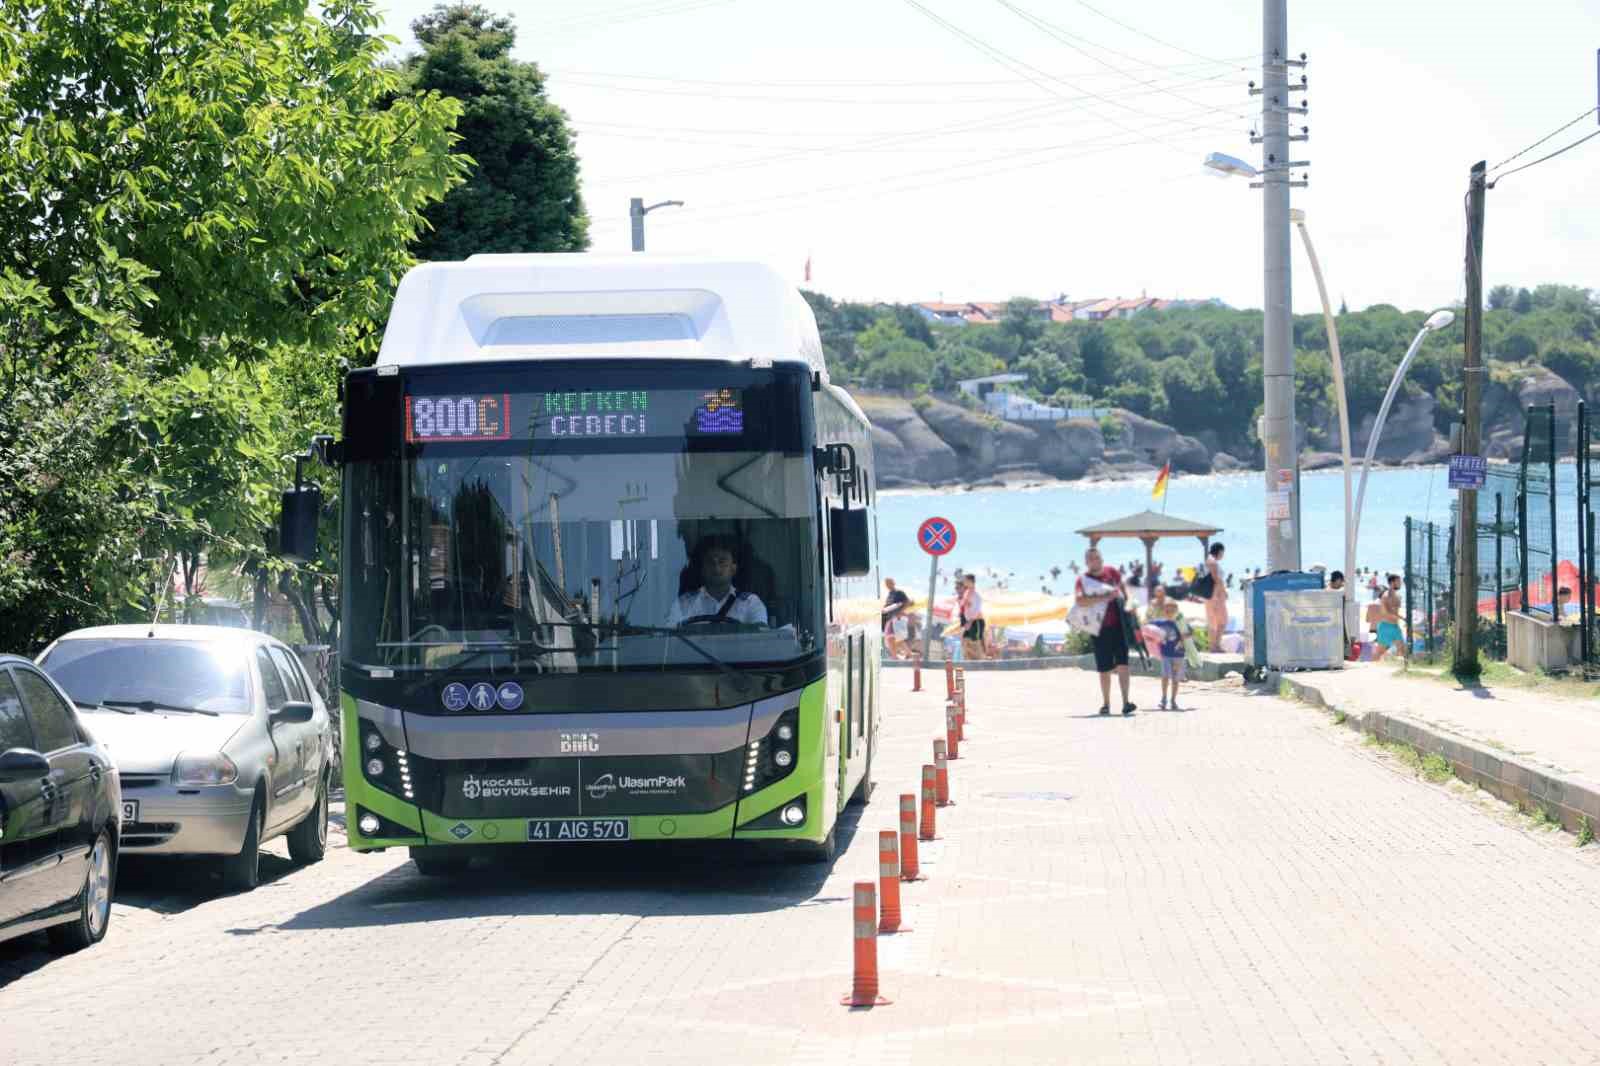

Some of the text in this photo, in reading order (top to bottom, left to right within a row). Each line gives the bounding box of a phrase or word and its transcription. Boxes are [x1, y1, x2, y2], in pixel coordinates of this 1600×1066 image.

[545, 391, 648, 412] KEFKEN
[415, 397, 498, 437] 800C
[560, 733, 599, 753] BMC
[533, 820, 624, 839] 41 AIG 570
